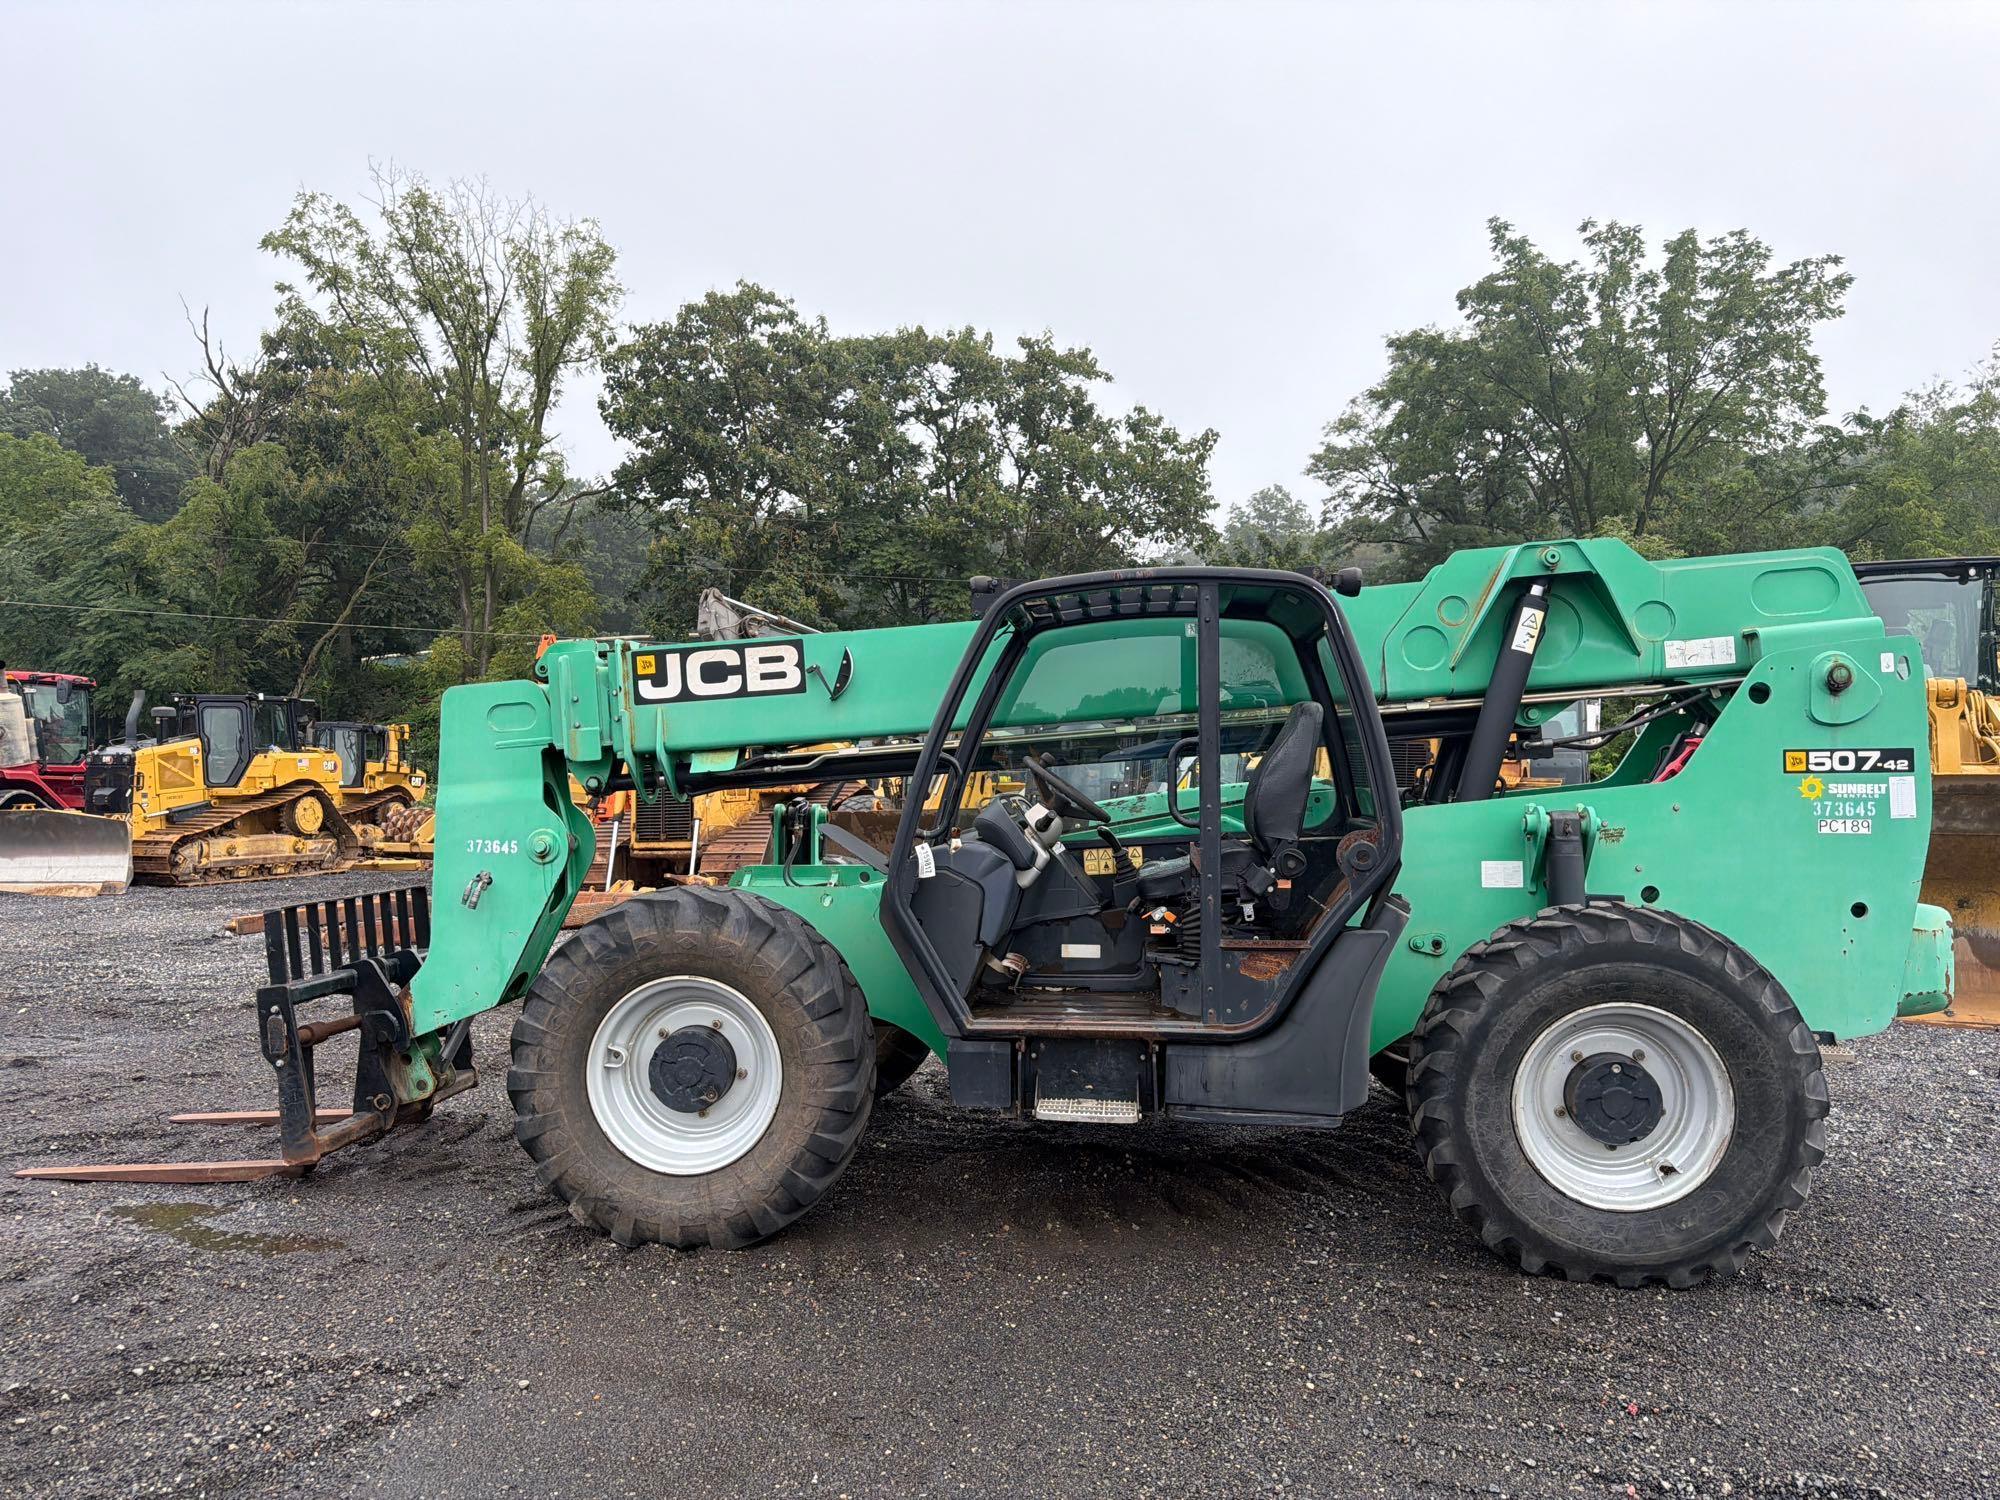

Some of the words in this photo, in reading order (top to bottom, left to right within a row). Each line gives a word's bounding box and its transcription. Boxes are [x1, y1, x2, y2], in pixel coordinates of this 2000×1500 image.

[638, 644, 801, 700] JCB
[323, 761, 335, 771] CAT
[1808, 751, 1909, 771] 507-42
[411, 777, 422, 787] CAT
[1828, 783, 1887, 795] SUNBELT
[1813, 801, 1876, 817] 373645
[1819, 819, 1870, 833] PC189
[467, 839, 518, 854] 373645
